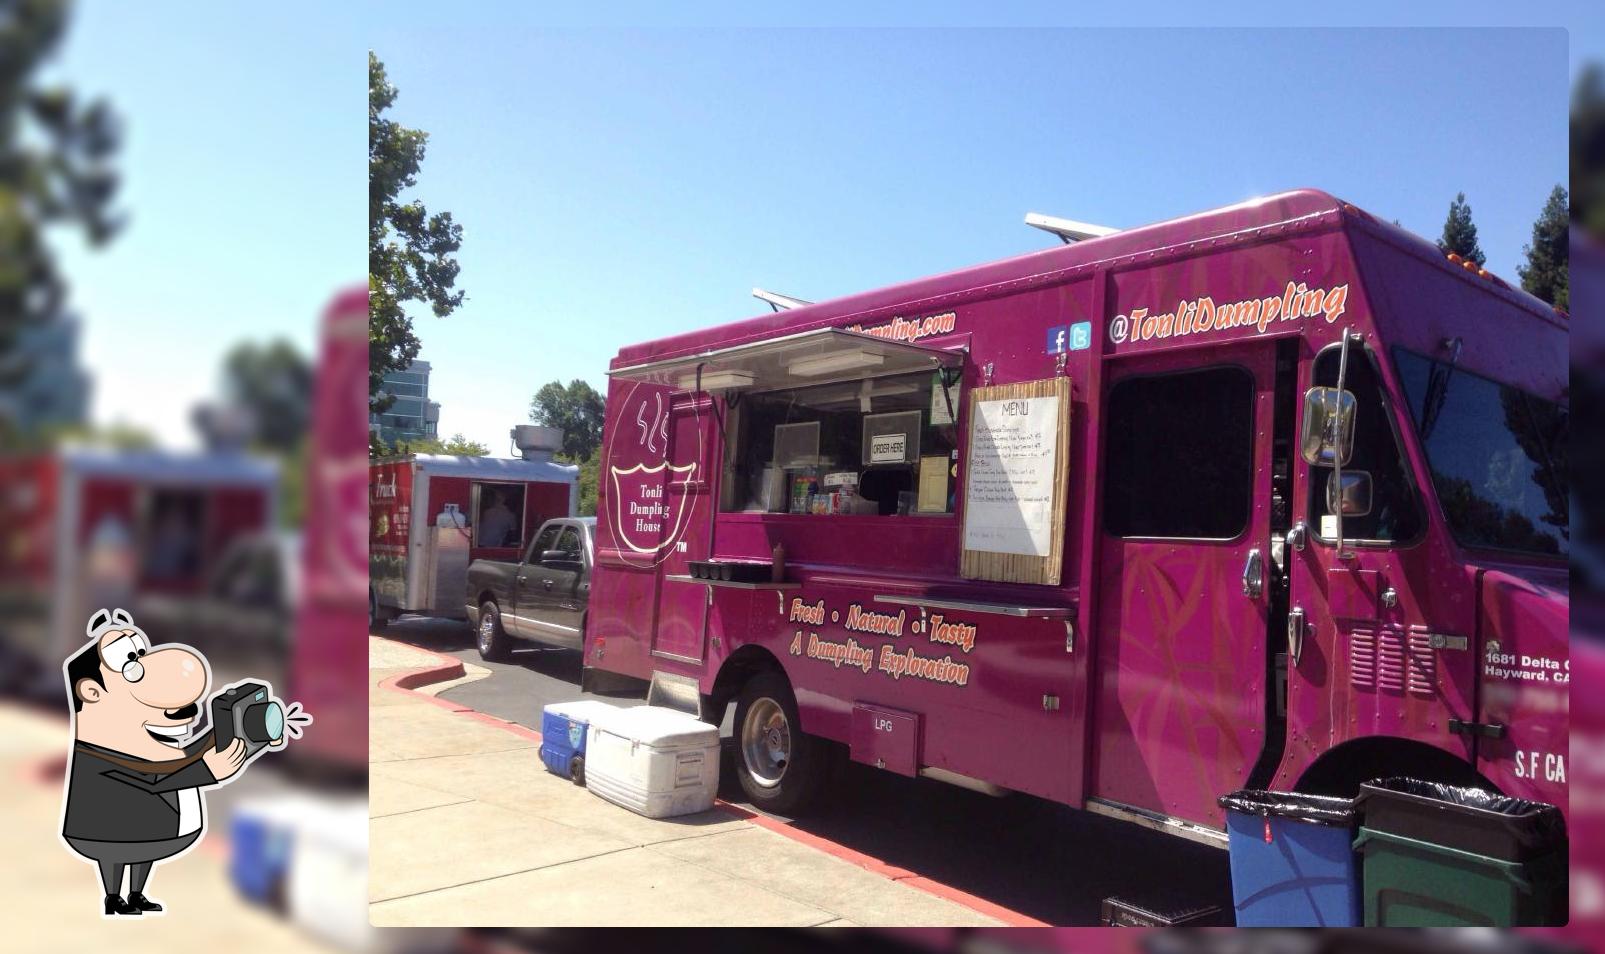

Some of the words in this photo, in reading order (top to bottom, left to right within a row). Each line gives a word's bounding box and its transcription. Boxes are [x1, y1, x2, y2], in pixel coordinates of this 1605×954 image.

[1109, 281, 1349, 344] @TonliDumpling
[1002, 401, 1029, 416] MENU
[873, 443, 890, 454] ORDER
[890, 442, 903, 453] HERE
[640, 484, 663, 498] Tonli
[789, 598, 825, 625] Fresh
[845, 604, 905, 637] Natural
[929, 614, 977, 653] Tasty
[790, 631, 802, 655] A
[807, 633, 874, 673] Dumpling
[879, 645, 969, 685] Exploration
[1485, 652, 1516, 665] 1681
[1521, 655, 1560, 670] Delta
[875, 718, 893, 732] LPG
[1515, 750, 1540, 779] S.F
[1545, 752, 1566, 783] CA
